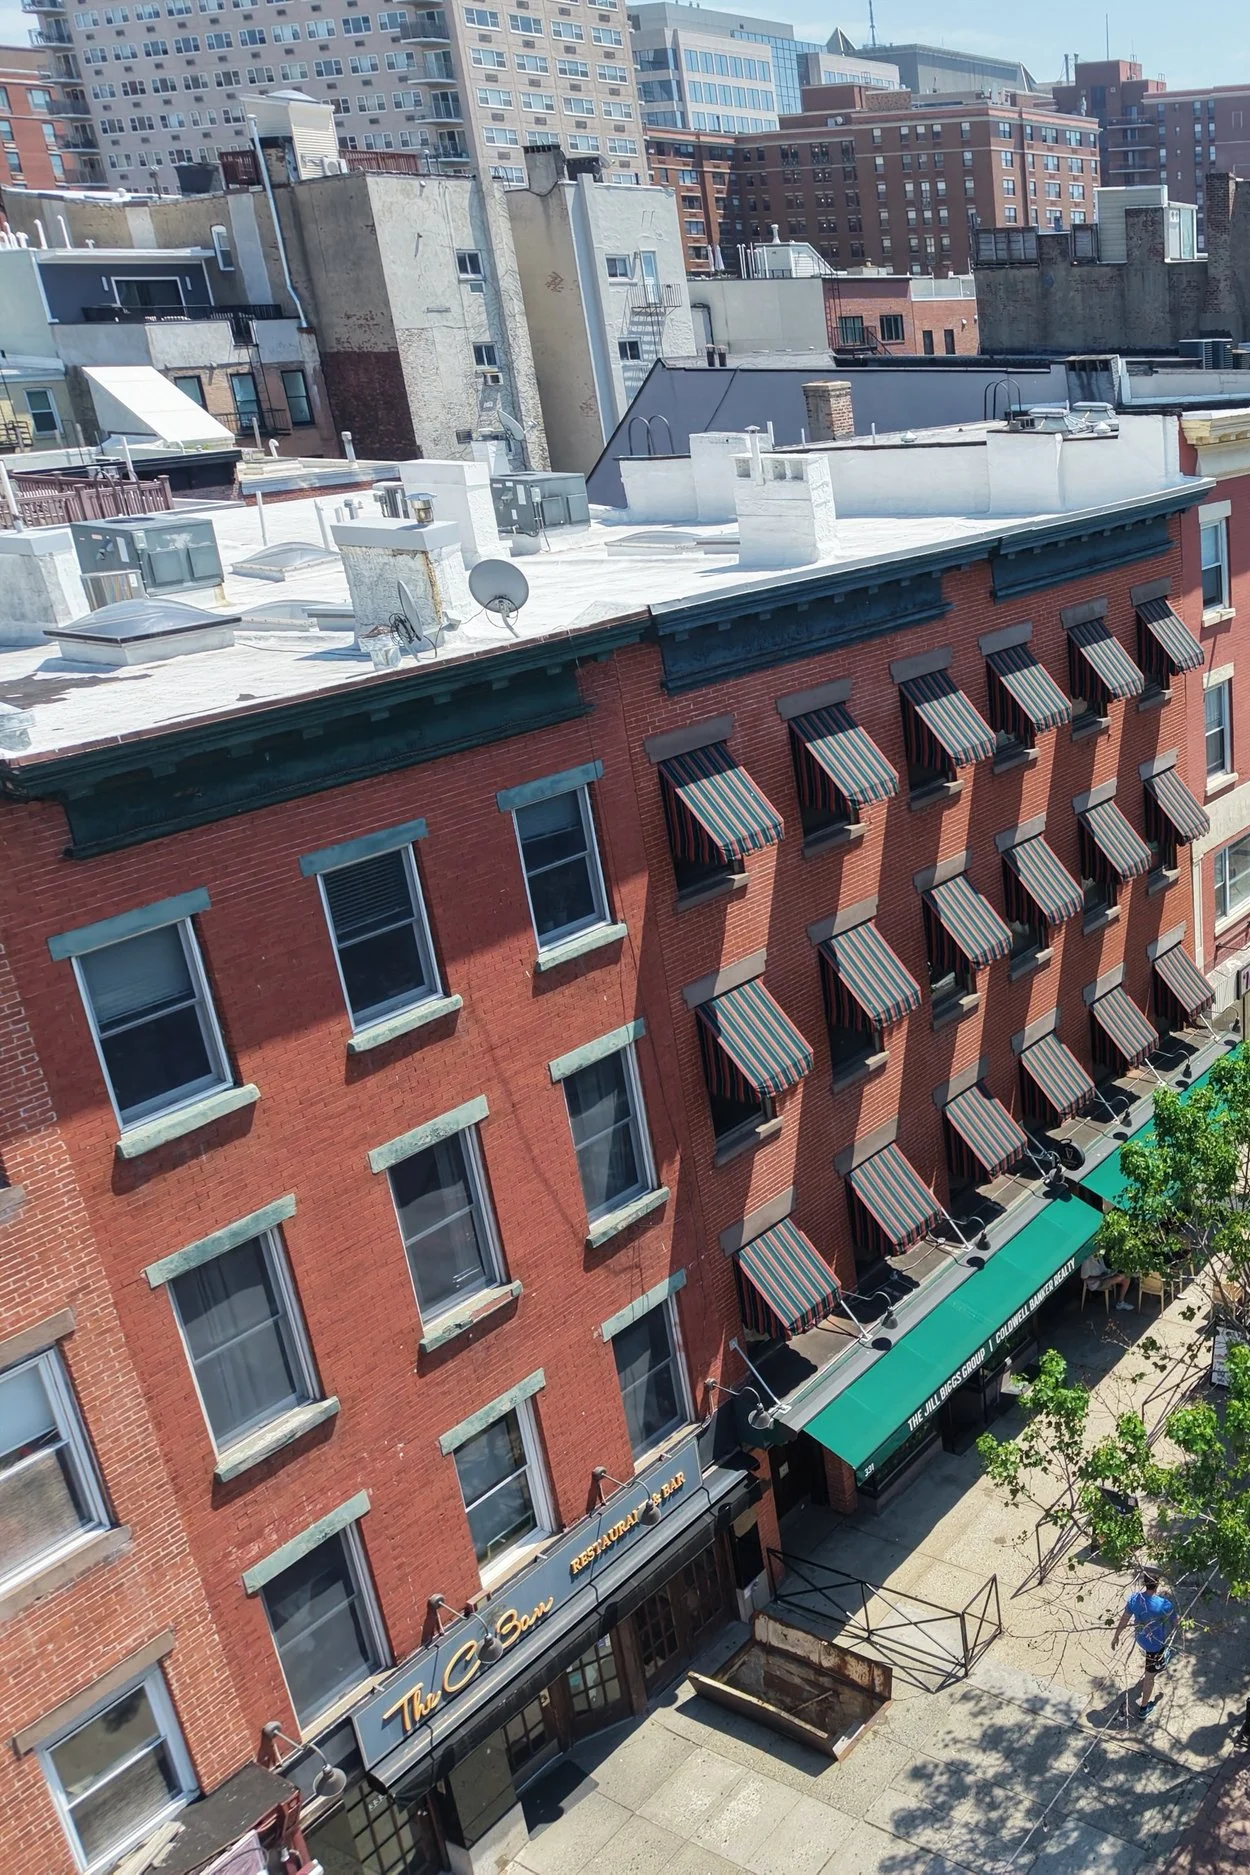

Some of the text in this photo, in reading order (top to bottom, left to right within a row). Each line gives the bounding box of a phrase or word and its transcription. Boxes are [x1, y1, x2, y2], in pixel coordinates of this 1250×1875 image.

[907, 1409, 924, 1432] THE
[924, 1394, 941, 1416] JILL
[940, 1371, 962, 1400] BIGGS
[961, 1348, 986, 1378] GROUP
[995, 1304, 1030, 1344] COLDWELL
[1029, 1279, 1054, 1312] BANKER
[1053, 1257, 1075, 1287] REALTY
[570, 1507, 645, 1575] RESTAURA
[661, 1471, 686, 1497] BAR
[382, 1682, 442, 1732] The
